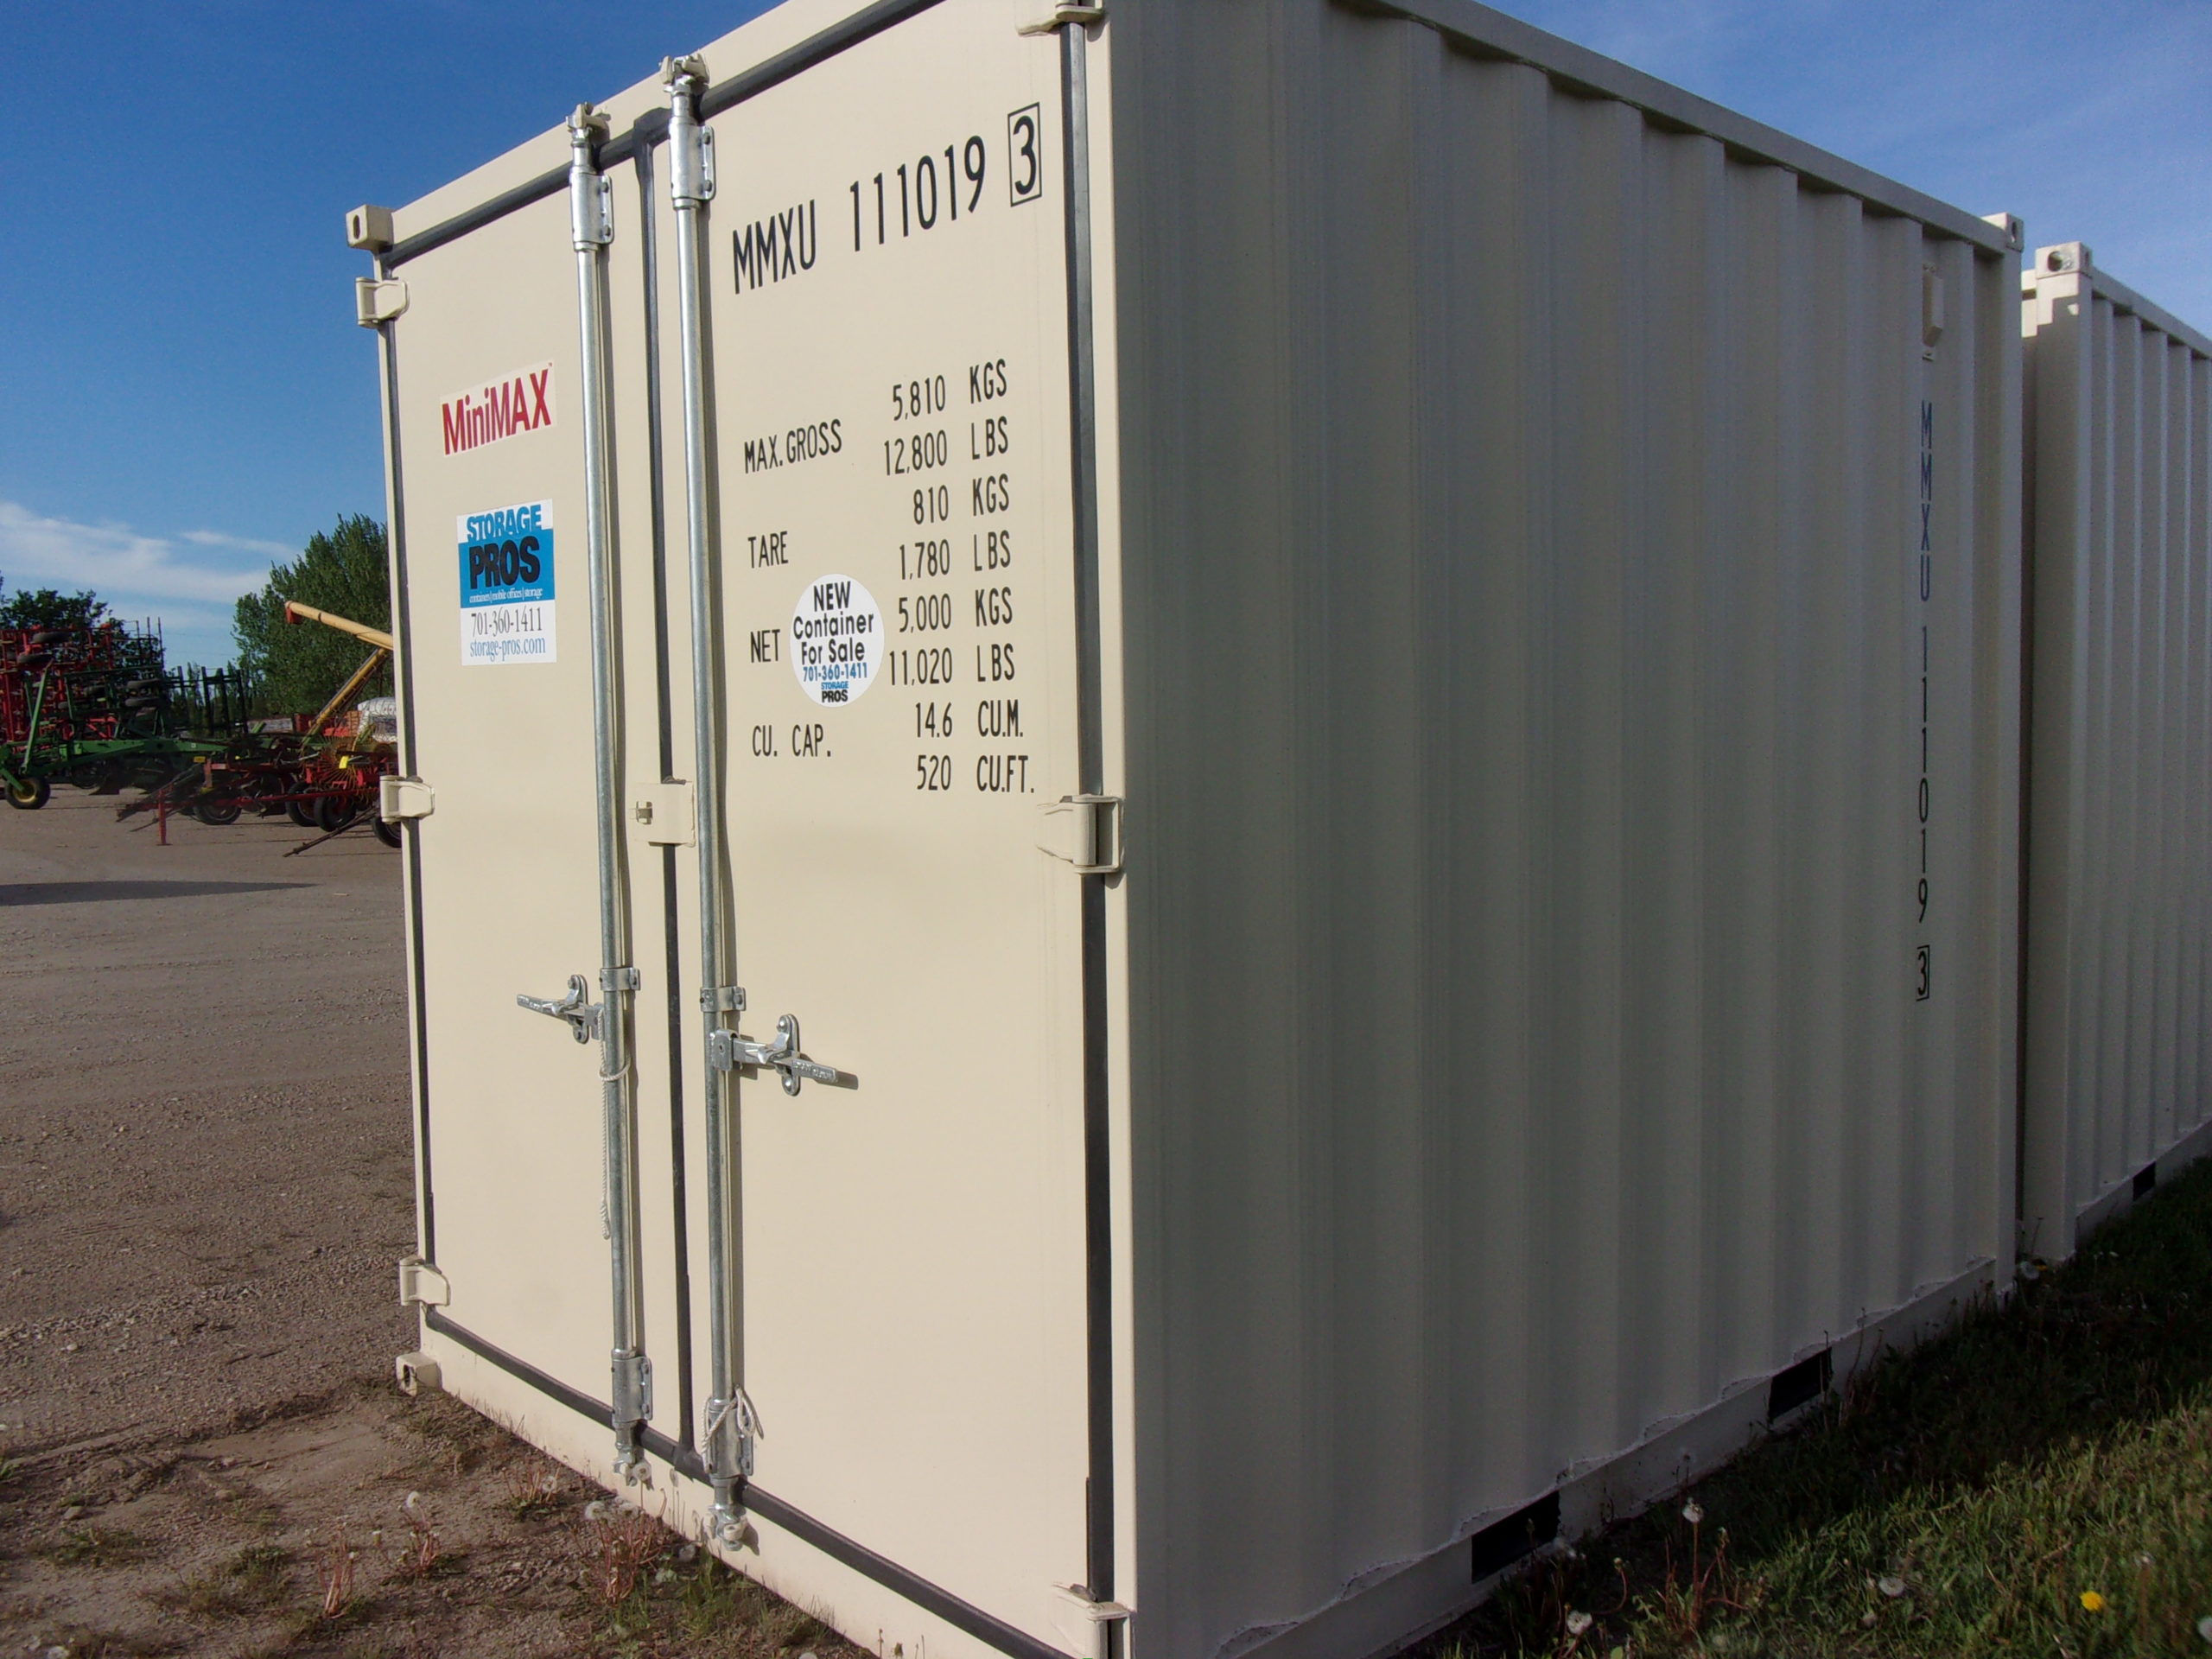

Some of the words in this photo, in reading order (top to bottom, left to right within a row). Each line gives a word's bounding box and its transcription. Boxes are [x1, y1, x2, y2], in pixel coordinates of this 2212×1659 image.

[732, 199, 817, 295] MMXU
[849, 135, 986, 252] 111019
[1011, 113, 1039, 197] 3
[969, 358, 1007, 404] KGS
[442, 369, 551, 455] MiniMAX
[970, 416, 1009, 461] LBS
[913, 485, 949, 525] 810
[972, 473, 1010, 517] KGS
[1920, 399, 1932, 602] MMXU
[467, 505, 542, 542] STORAGE
[469, 536, 541, 589] PROS
[747, 531, 789, 569] TARE
[973, 530, 1012, 572] LBS
[813, 581, 851, 613] NEW
[975, 586, 1014, 627] KGS
[471, 605, 543, 637] 701-360-1411
[793, 611, 874, 639] Container
[470, 638, 546, 662] storage-pros.com
[750, 628, 781, 664] NET
[976, 643, 1015, 683] LBS
[801, 641, 823, 665] For
[828, 637, 865, 663] Sale
[803, 662, 868, 682] 701-360-1411
[821, 681, 849, 690] STORAGE
[821, 690, 849, 703] PROS
[752, 724, 779, 757] CU.
[791, 723, 832, 758] CAP.
[915, 702, 953, 738] 14.6
[977, 699, 1025, 738] CU.M.
[916, 754, 952, 791] 520
[976, 754, 1036, 793] CU.FT.
[1917, 626, 1929, 923] 111019
